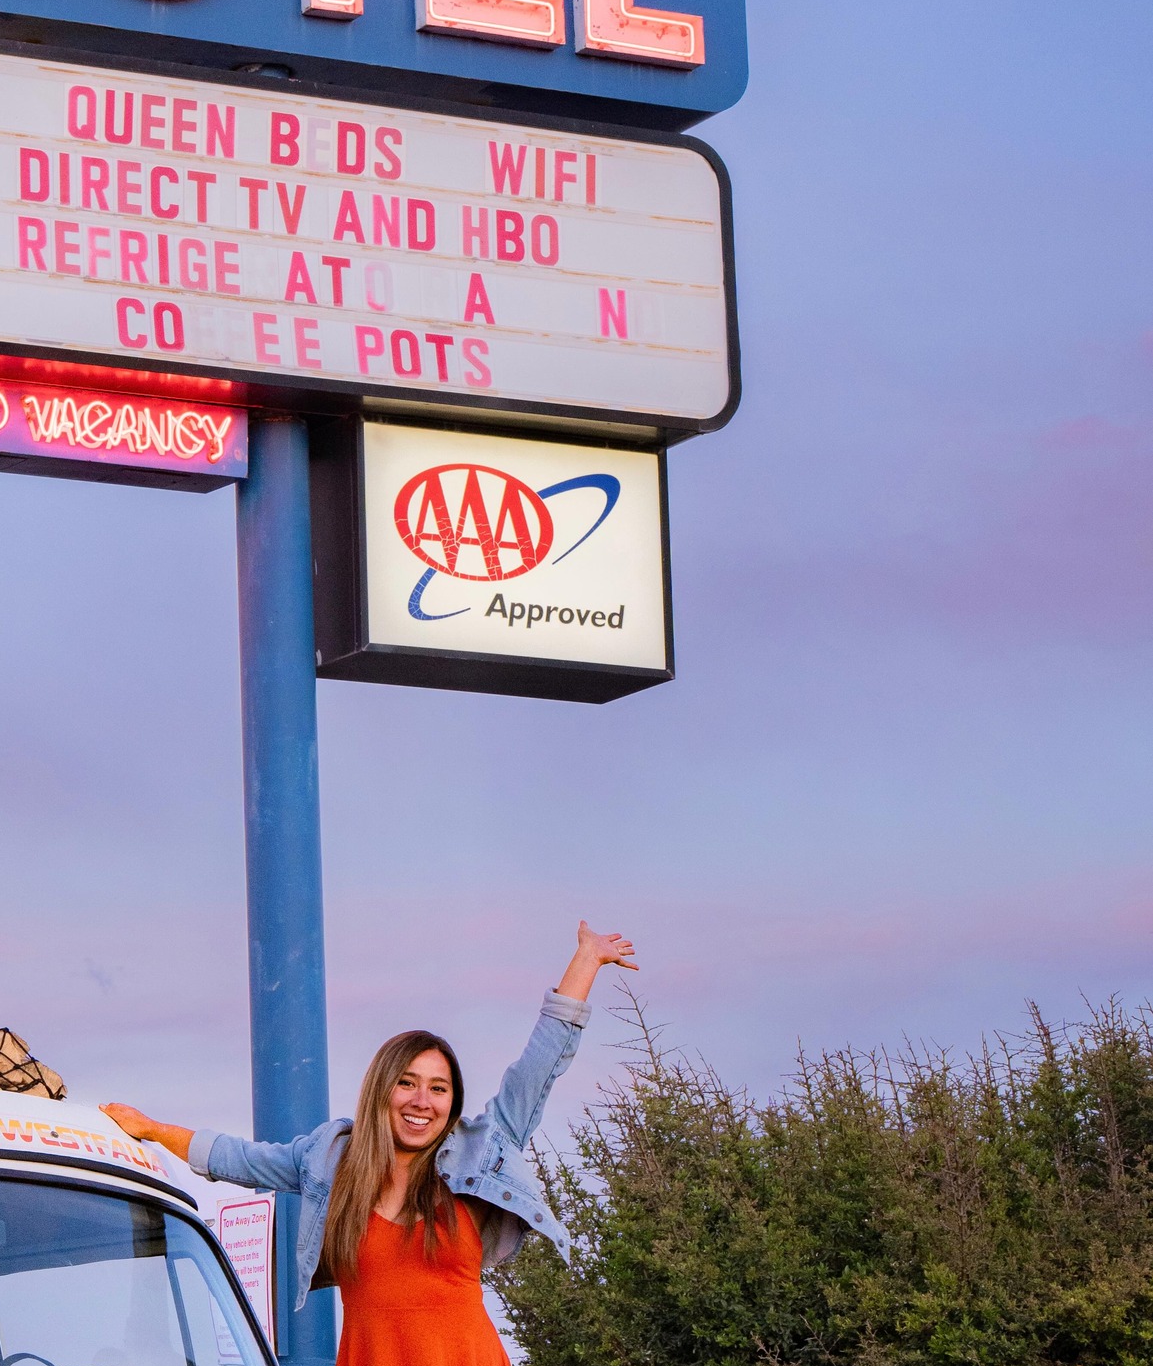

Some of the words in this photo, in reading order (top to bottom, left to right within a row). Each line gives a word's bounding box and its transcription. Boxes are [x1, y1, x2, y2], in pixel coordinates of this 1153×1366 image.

[67, 85, 236, 159] QUEEN
[271, 112, 403, 180] BEDS
[488, 140, 598, 207] WIFI
[19, 147, 217, 223] DIRECT
[239, 176, 307, 235] TV
[333, 190, 436, 252] AND
[462, 204, 560, 266] HBO
[354, 324, 492, 387] POTS
[22, 395, 232, 463] VACANCY
[400, 464, 550, 581] AAA
[484, 592, 625, 630] Approved
[223, 1217, 235, 1228] Tow
[235, 1216, 250, 1227] Away
[251, 1213, 267, 1224] Zone
